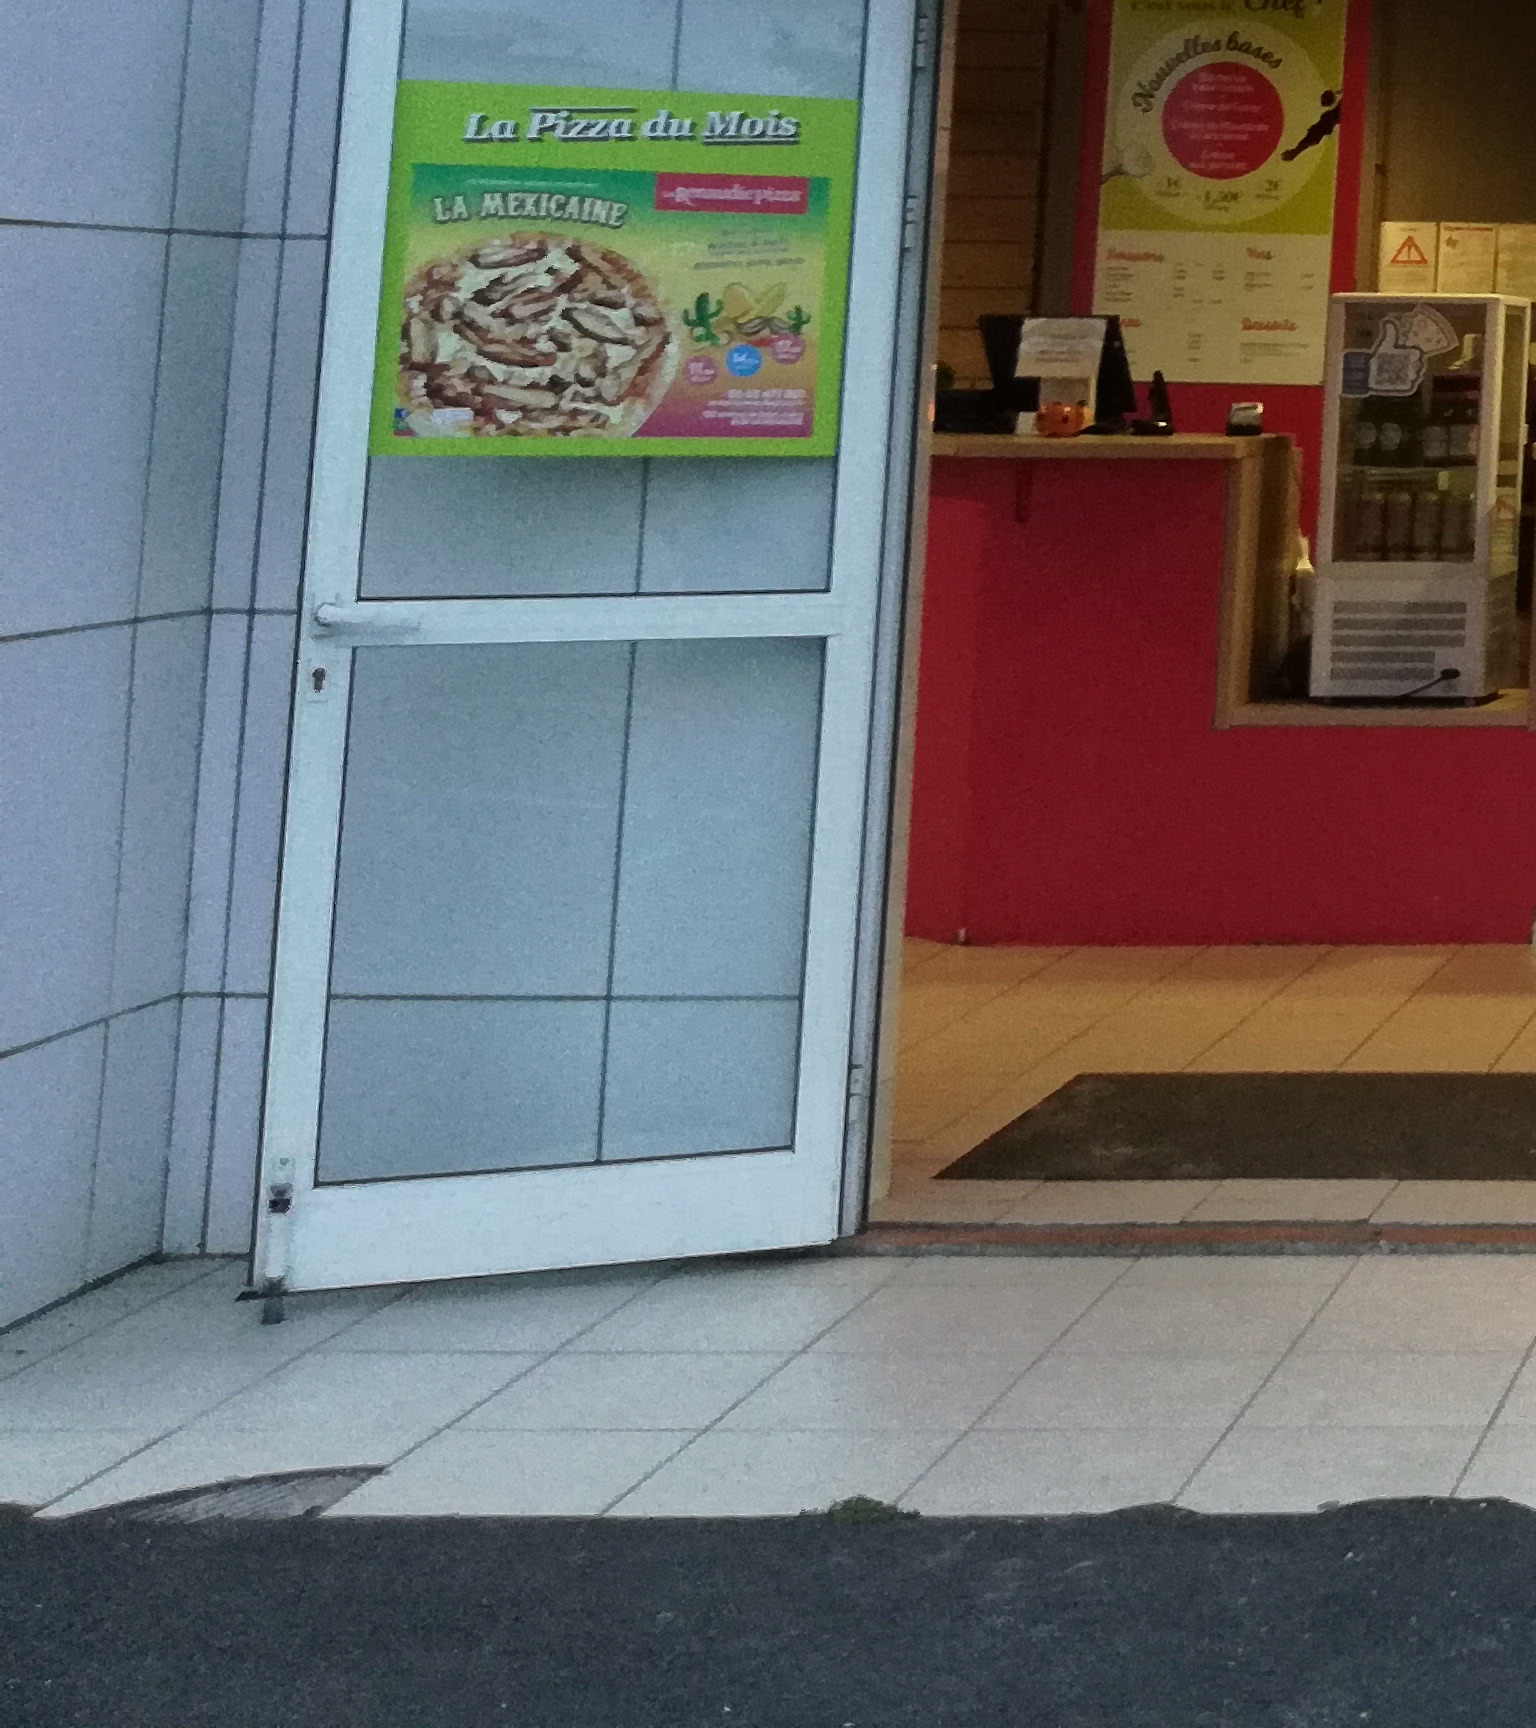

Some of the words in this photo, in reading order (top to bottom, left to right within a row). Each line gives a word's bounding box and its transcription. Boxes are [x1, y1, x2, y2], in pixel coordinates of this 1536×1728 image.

[1131, 35, 1222, 113] Nouvelles
[1225, 30, 1284, 69] bases
[463, 112, 518, 143] La
[526, 110, 634, 142] Pizza
[642, 108, 696, 141] du
[702, 110, 799, 142] Mois
[433, 196, 469, 222] LA
[479, 190, 629, 229] MEXICAINE
